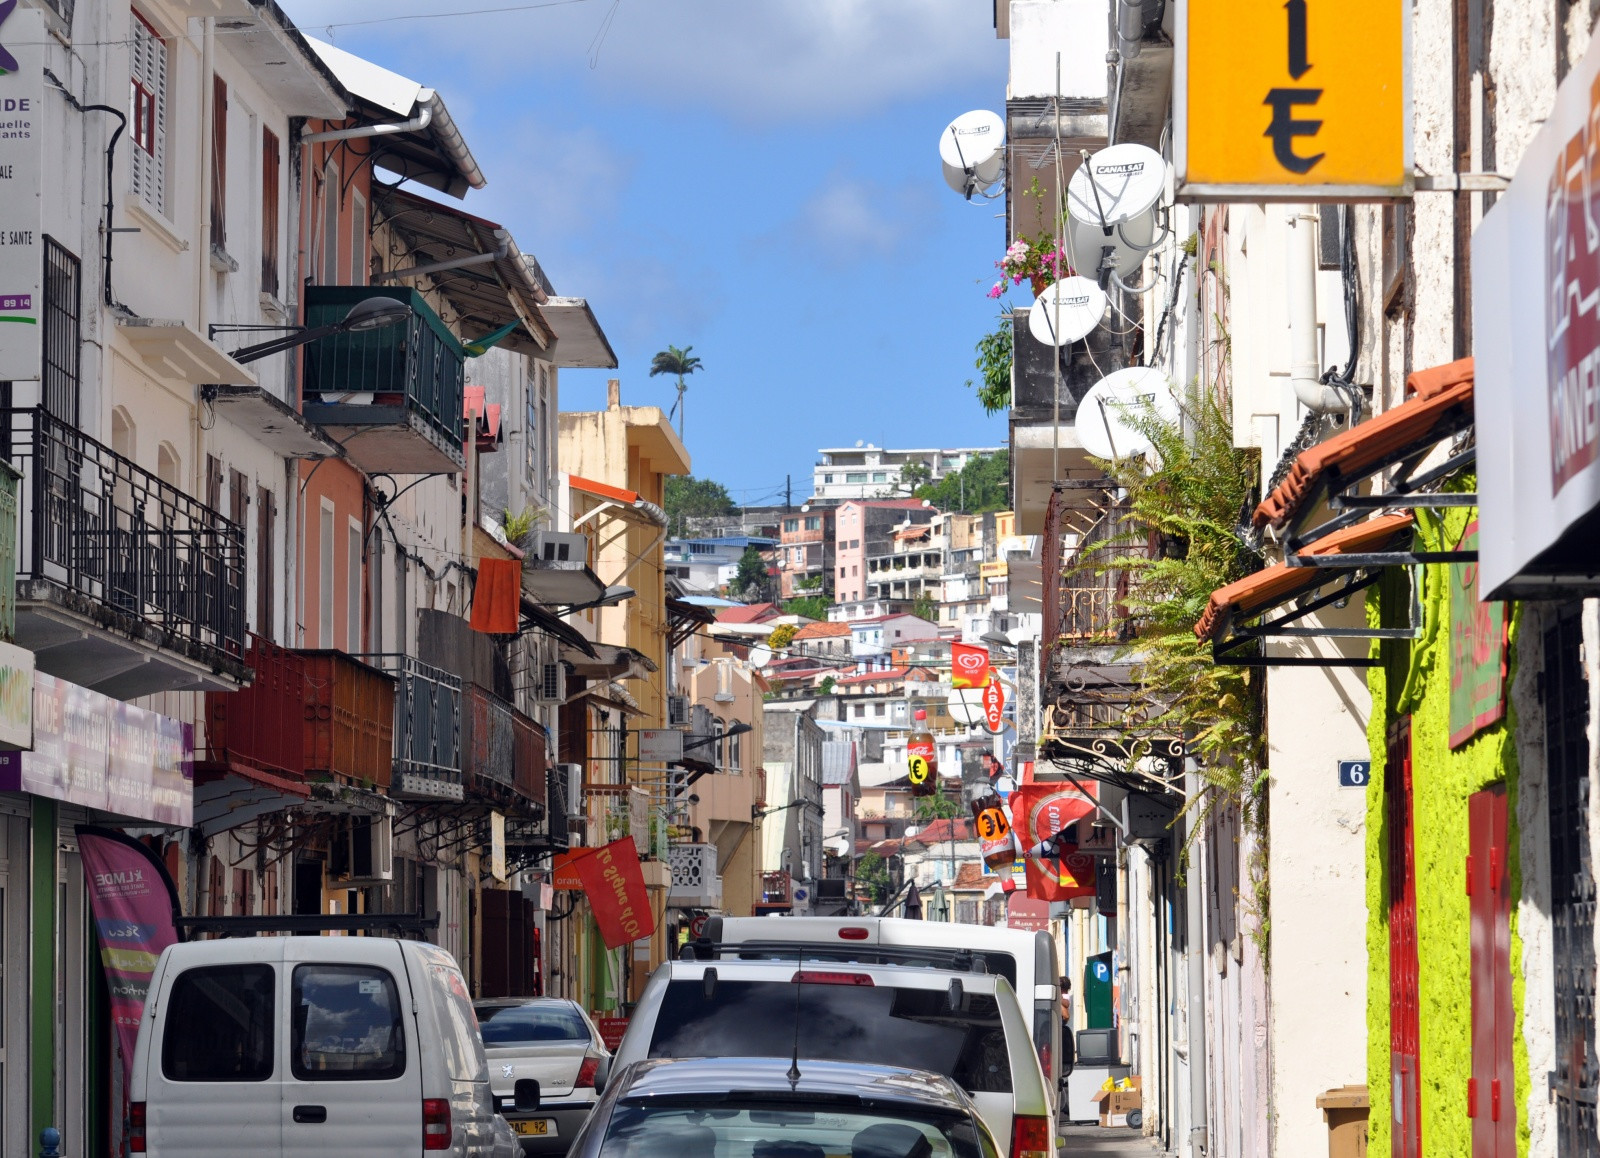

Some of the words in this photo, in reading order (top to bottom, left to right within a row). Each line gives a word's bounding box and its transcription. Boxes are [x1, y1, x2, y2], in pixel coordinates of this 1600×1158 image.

[1096, 162, 1144, 175] CANALSAT
[9, 231, 33, 246] SANTE
[3, 299, 17, 308] 89
[20, 298, 31, 307] 14
[987, 676, 1000, 723] TABAC
[981, 812, 1006, 837] 1€
[1096, 963, 1107, 979] P
